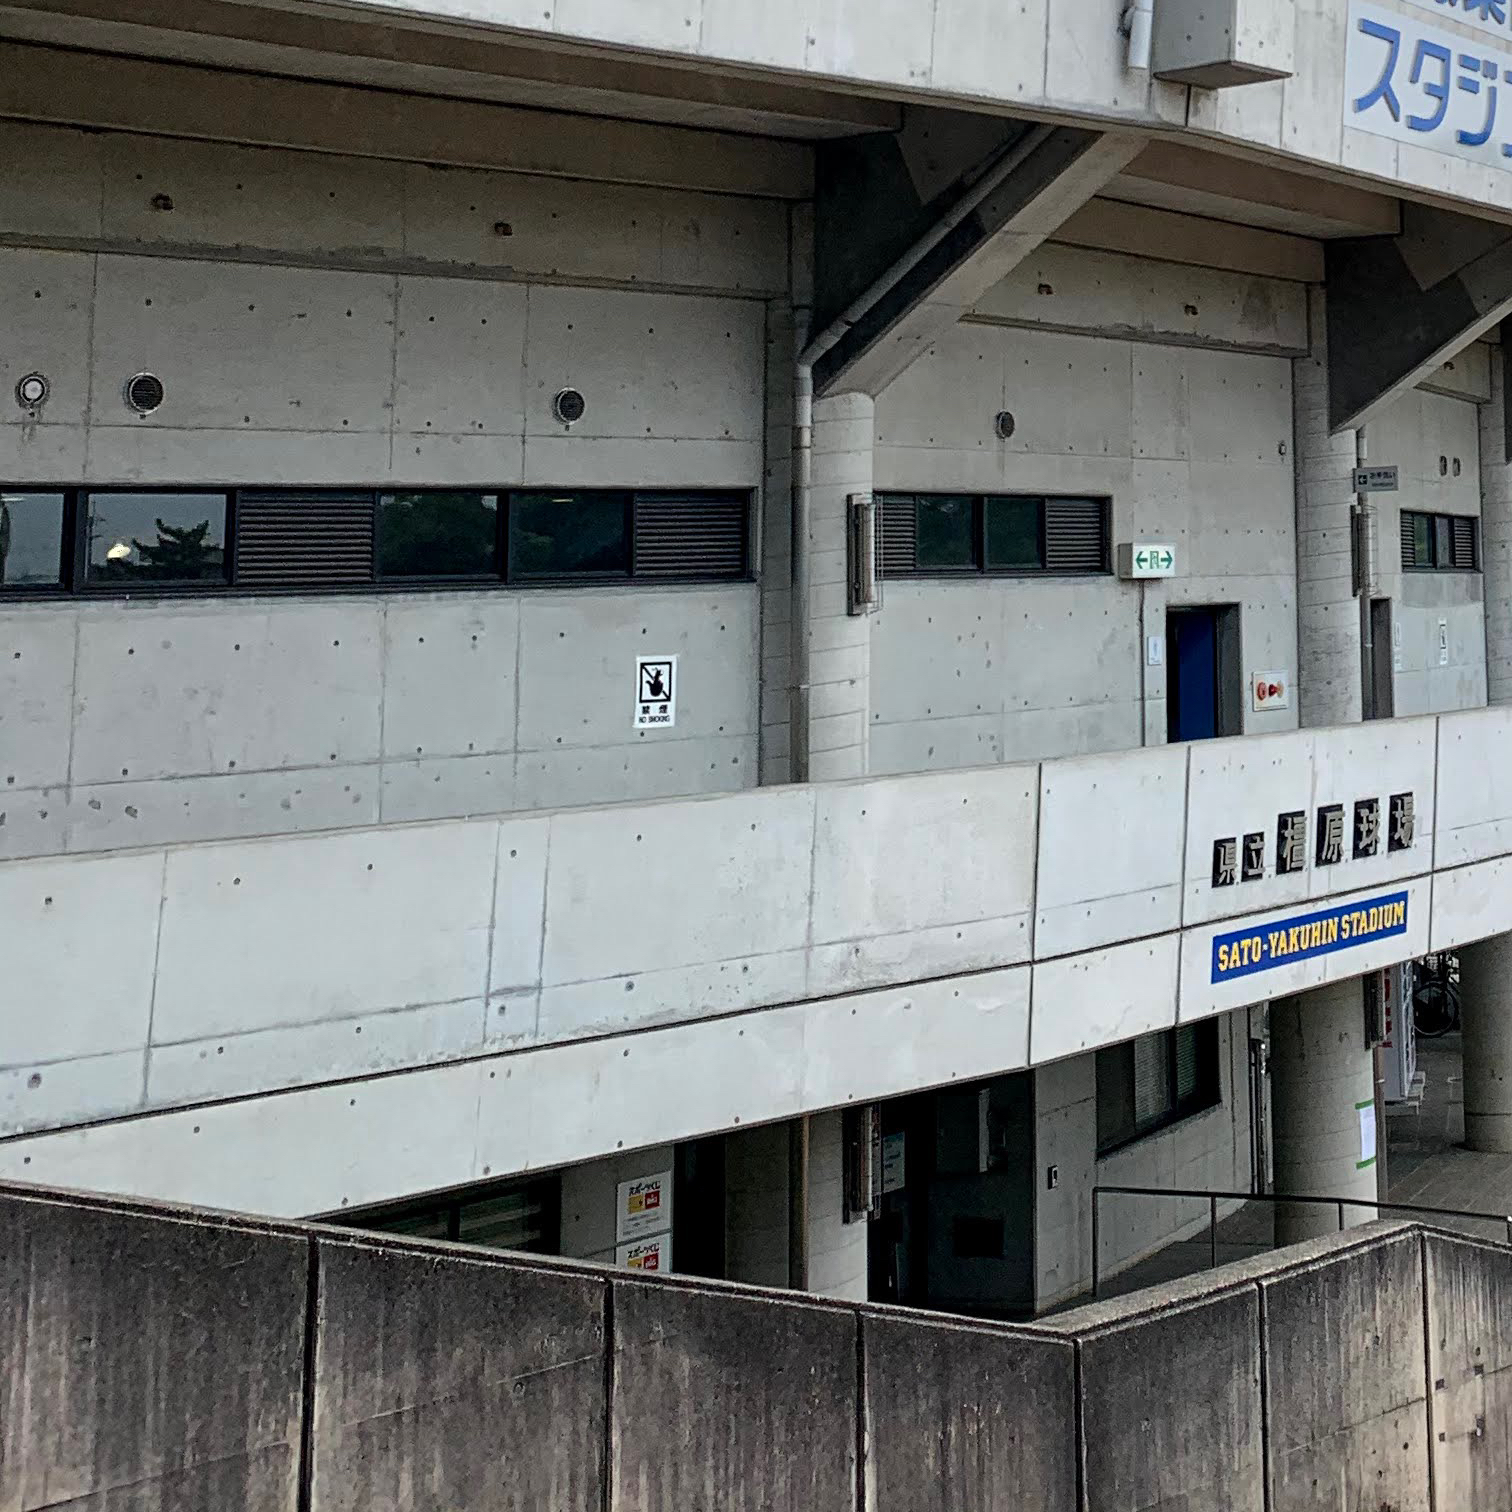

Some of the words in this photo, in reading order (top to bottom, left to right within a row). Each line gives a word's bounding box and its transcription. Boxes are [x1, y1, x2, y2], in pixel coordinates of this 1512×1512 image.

[1218, 796, 1416, 885] 県立橿原球場
[1341, 900, 1405, 939] STADIUM
